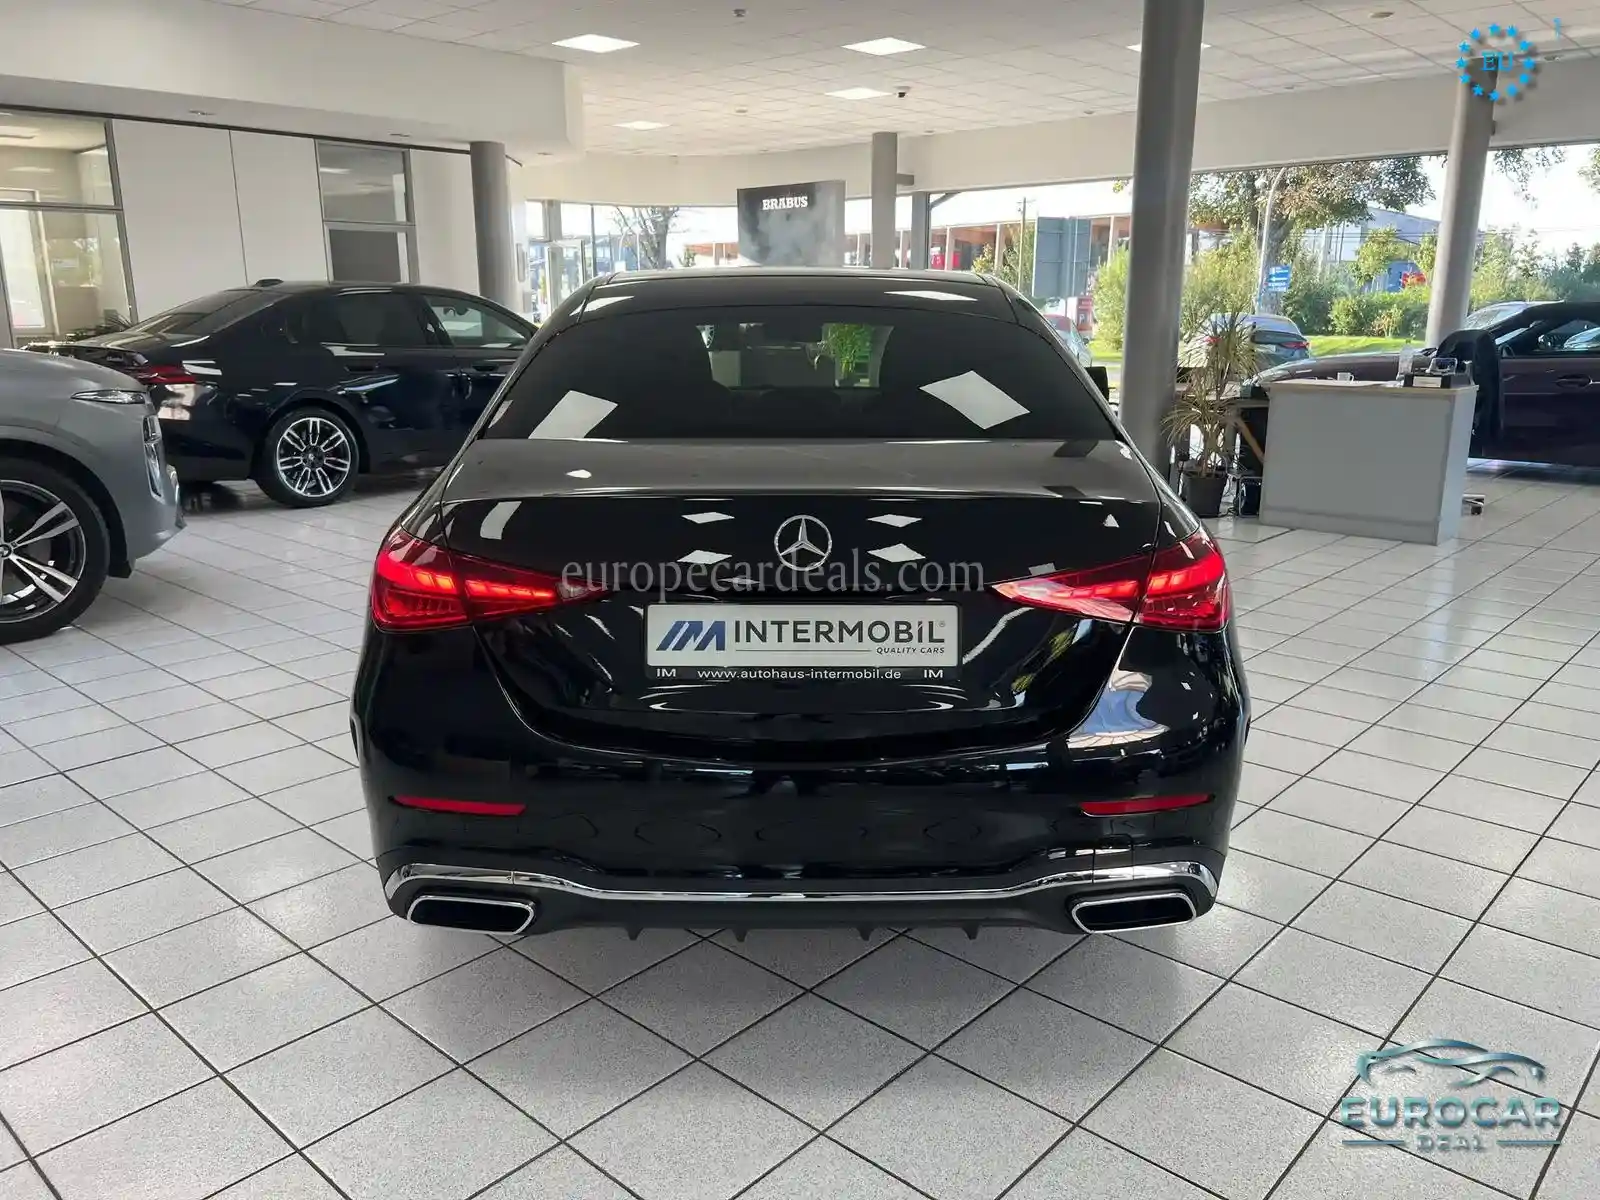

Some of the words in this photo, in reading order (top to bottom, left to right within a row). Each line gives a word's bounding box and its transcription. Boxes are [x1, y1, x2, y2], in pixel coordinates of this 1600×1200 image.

[762, 196, 808, 210] BRABUS
[876, 647, 917, 655] QUALITY
[656, 669, 677, 678] IM
[697, 668, 902, 680] www.autohaus-intermobil.de
[924, 669, 944, 679] IM
